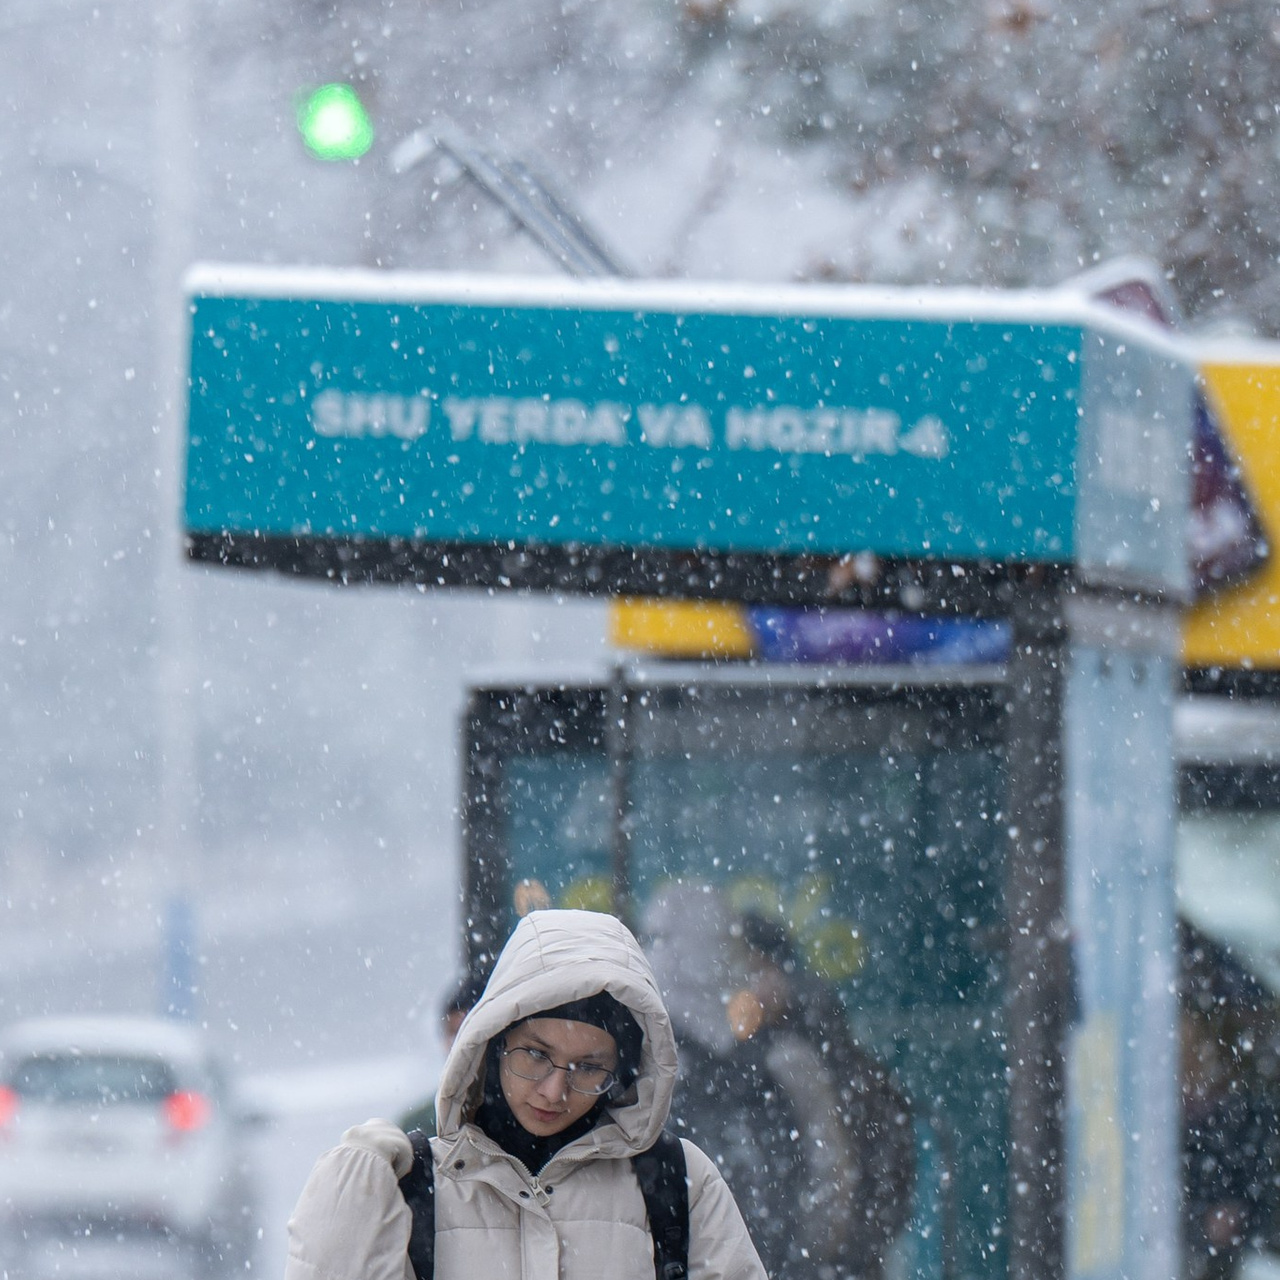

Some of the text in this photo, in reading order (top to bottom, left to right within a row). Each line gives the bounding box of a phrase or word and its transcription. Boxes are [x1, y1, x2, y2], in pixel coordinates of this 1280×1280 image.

[312, 389, 431, 439] SHU
[443, 395, 628, 446] YERDA
[637, 402, 714, 448] VA
